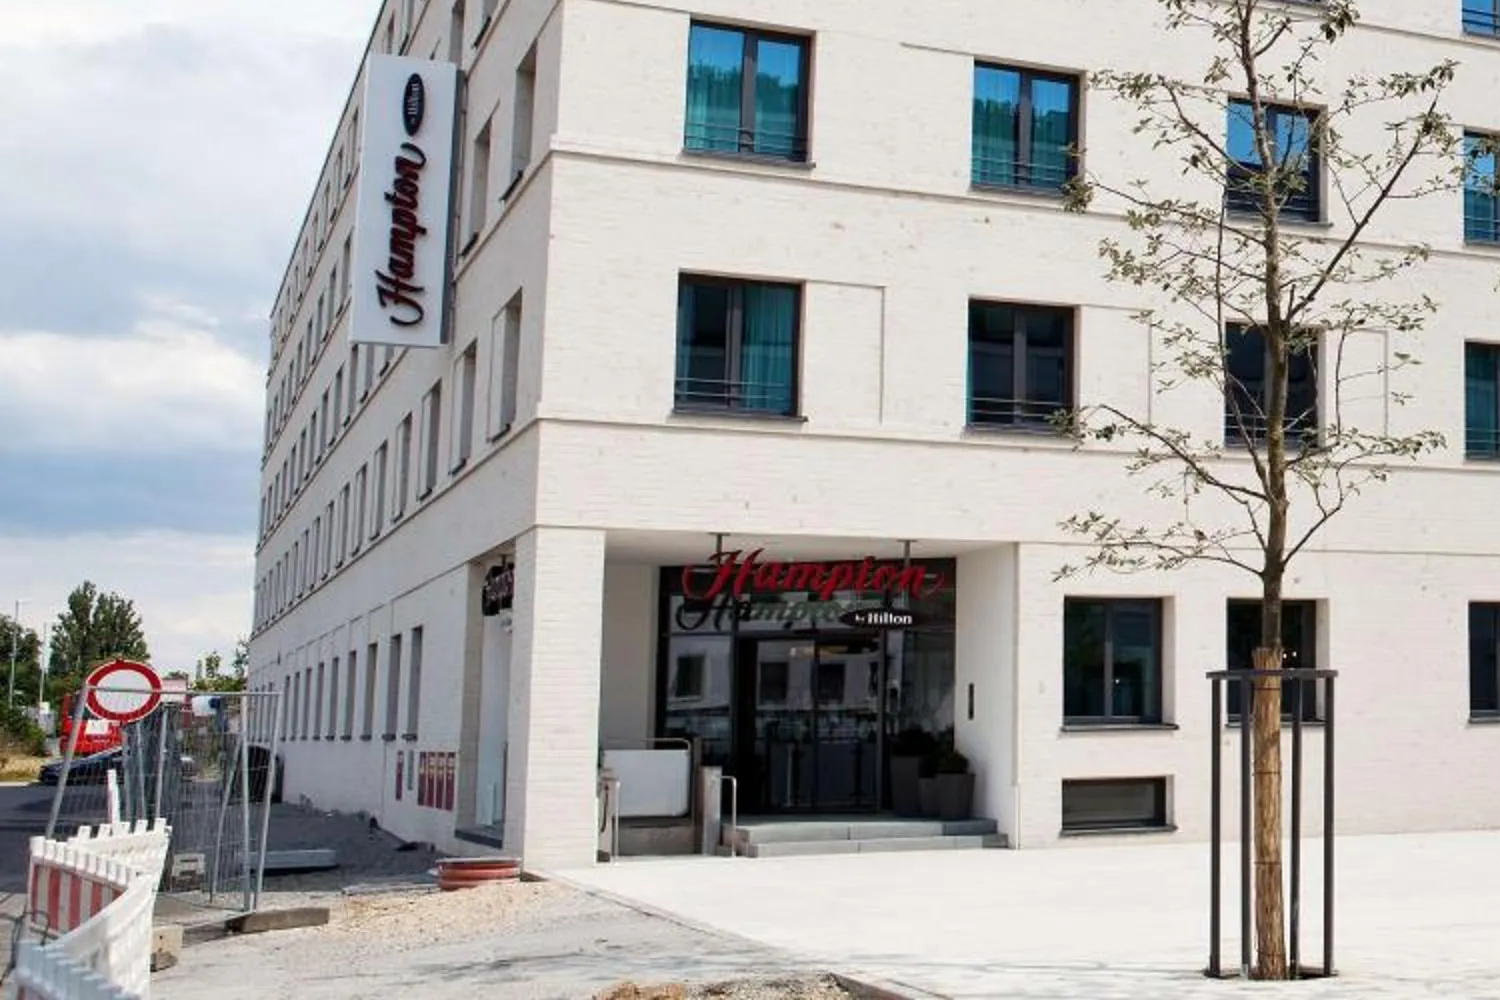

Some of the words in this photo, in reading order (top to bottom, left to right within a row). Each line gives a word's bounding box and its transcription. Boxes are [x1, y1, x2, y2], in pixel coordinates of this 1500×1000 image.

[375, 142, 427, 328] Hampton
[681, 547, 945, 601] Hampton
[867, 611, 913, 625] Hilton
